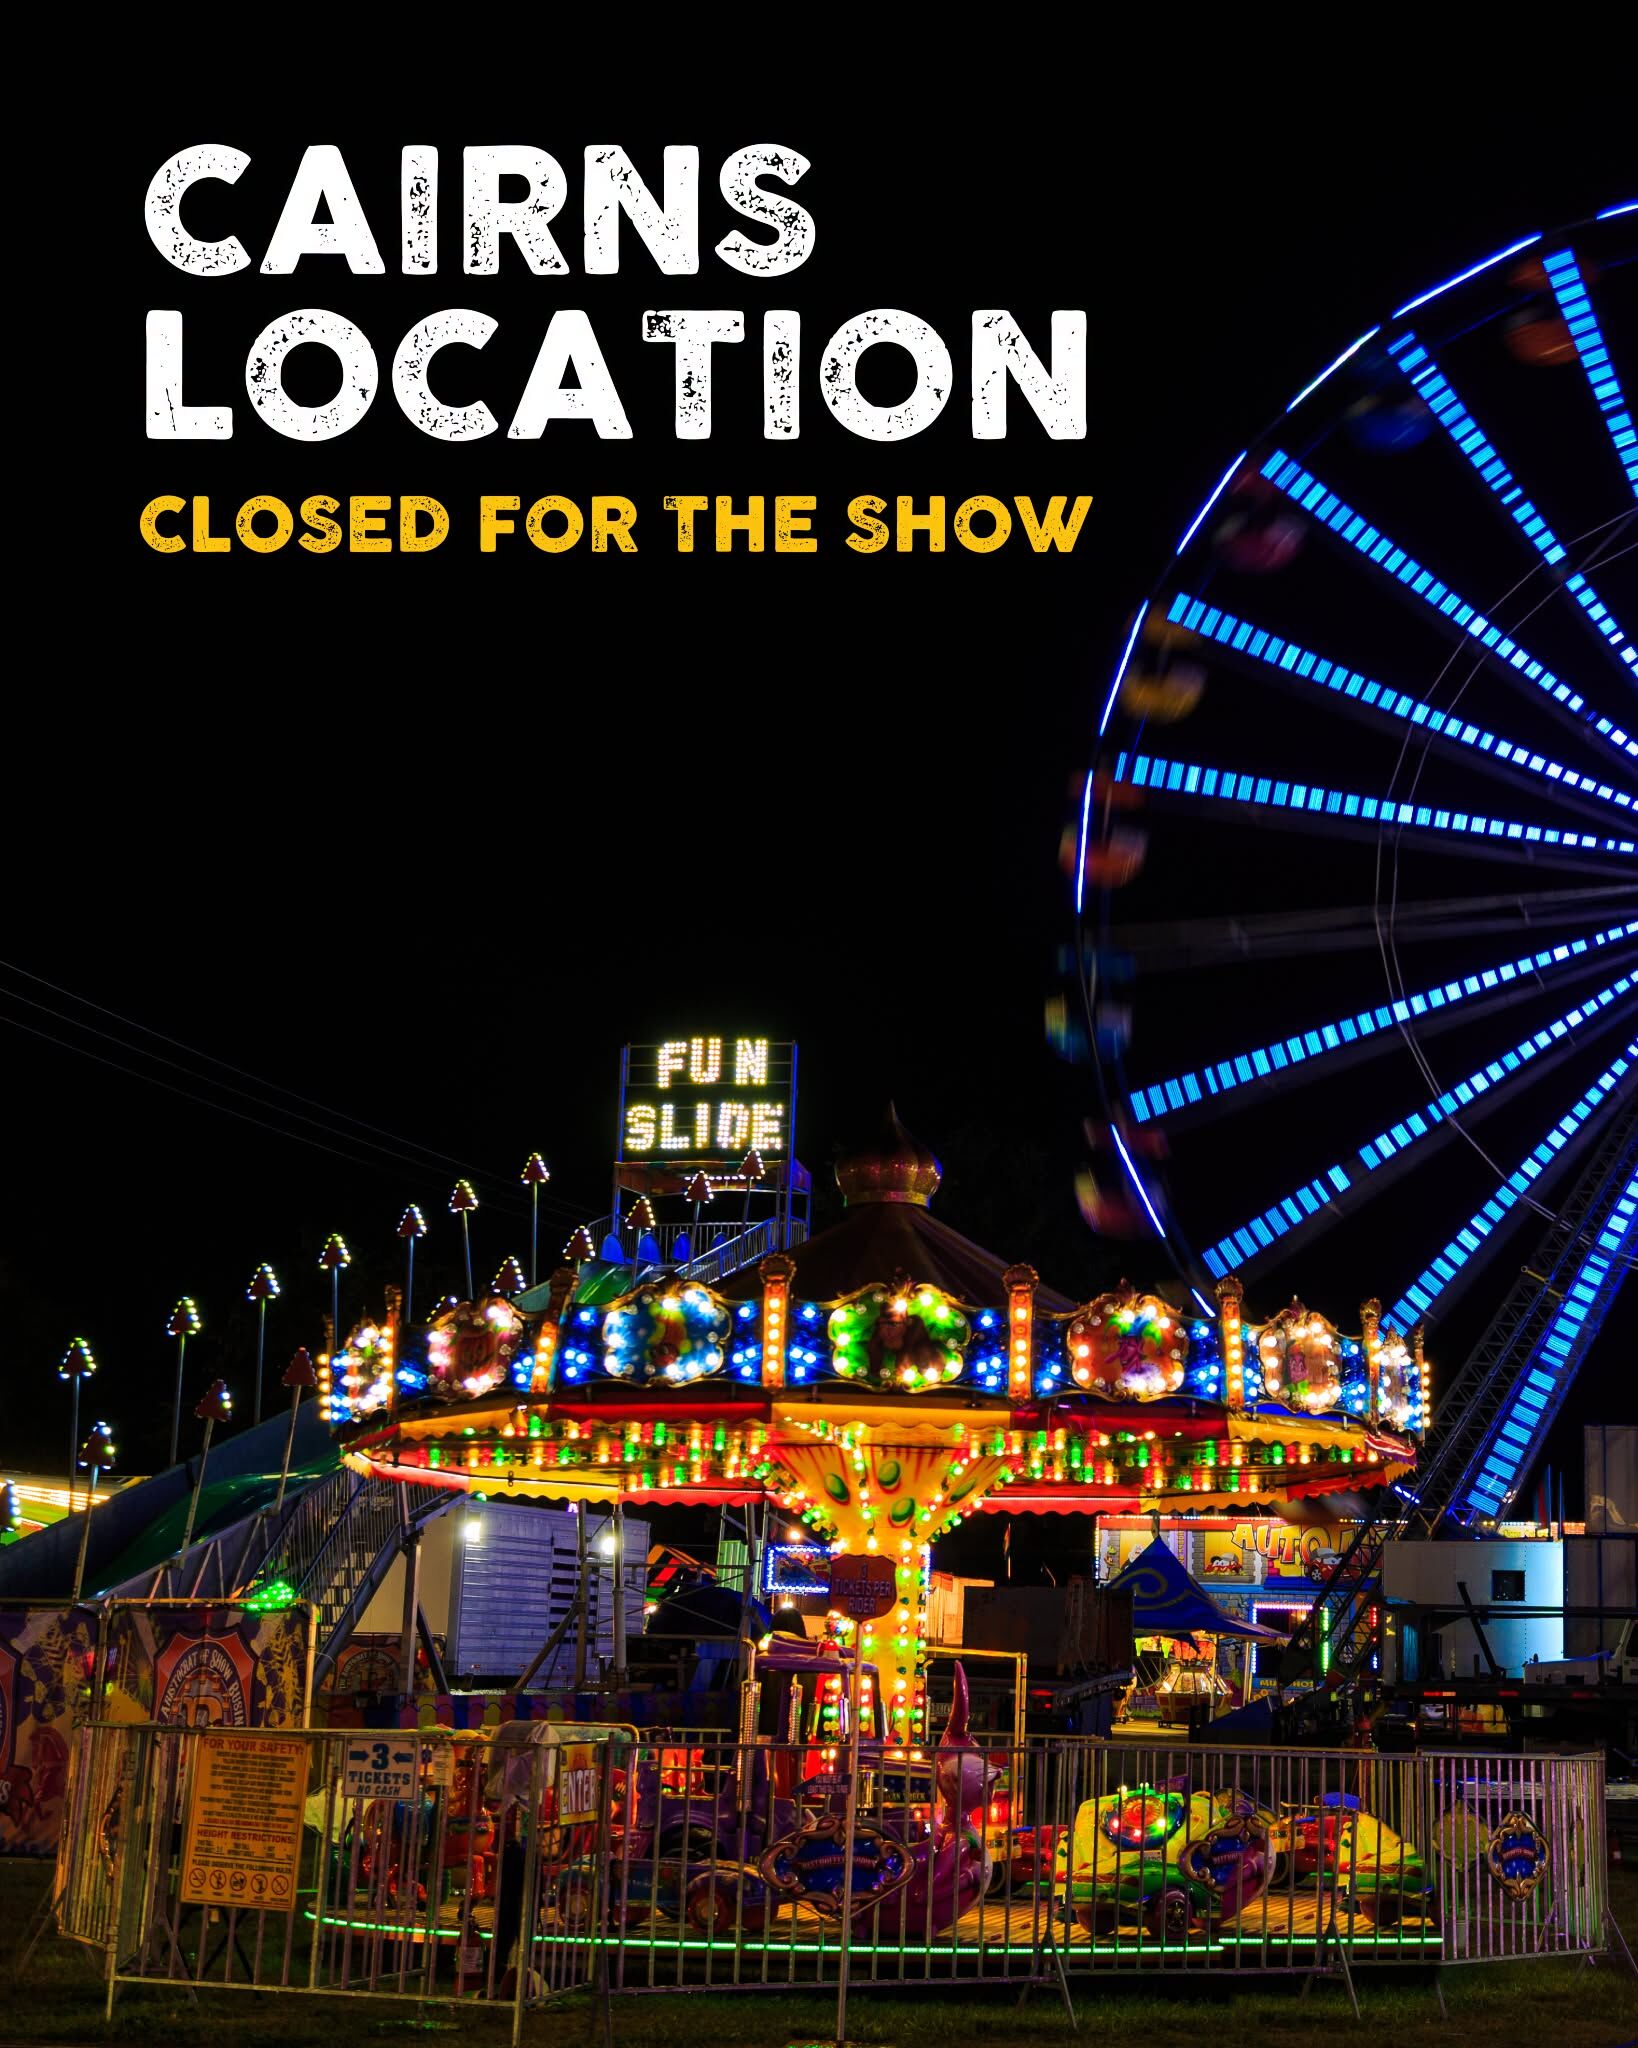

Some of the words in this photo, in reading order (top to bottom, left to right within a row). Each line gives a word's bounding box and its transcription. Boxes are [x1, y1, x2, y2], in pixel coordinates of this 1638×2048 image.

[656, 1038, 768, 1089] FUN
[625, 1102, 783, 1150] SLIDE
[1230, 1523, 1331, 1565] AUTO
[834, 1578, 872, 1597] TICKETS
[847, 1597, 877, 1615] RIDER
[210, 1648, 233, 1681] SHOW
[203, 1738, 224, 1750] FOR
[227, 1739, 257, 1752] YOUR
[371, 1743, 389, 1770] 3
[348, 1771, 411, 1785] TICKETS
[357, 1784, 371, 1795] NO
[374, 1785, 401, 1796] CASH
[197, 1829, 228, 1838] HEIGHT
